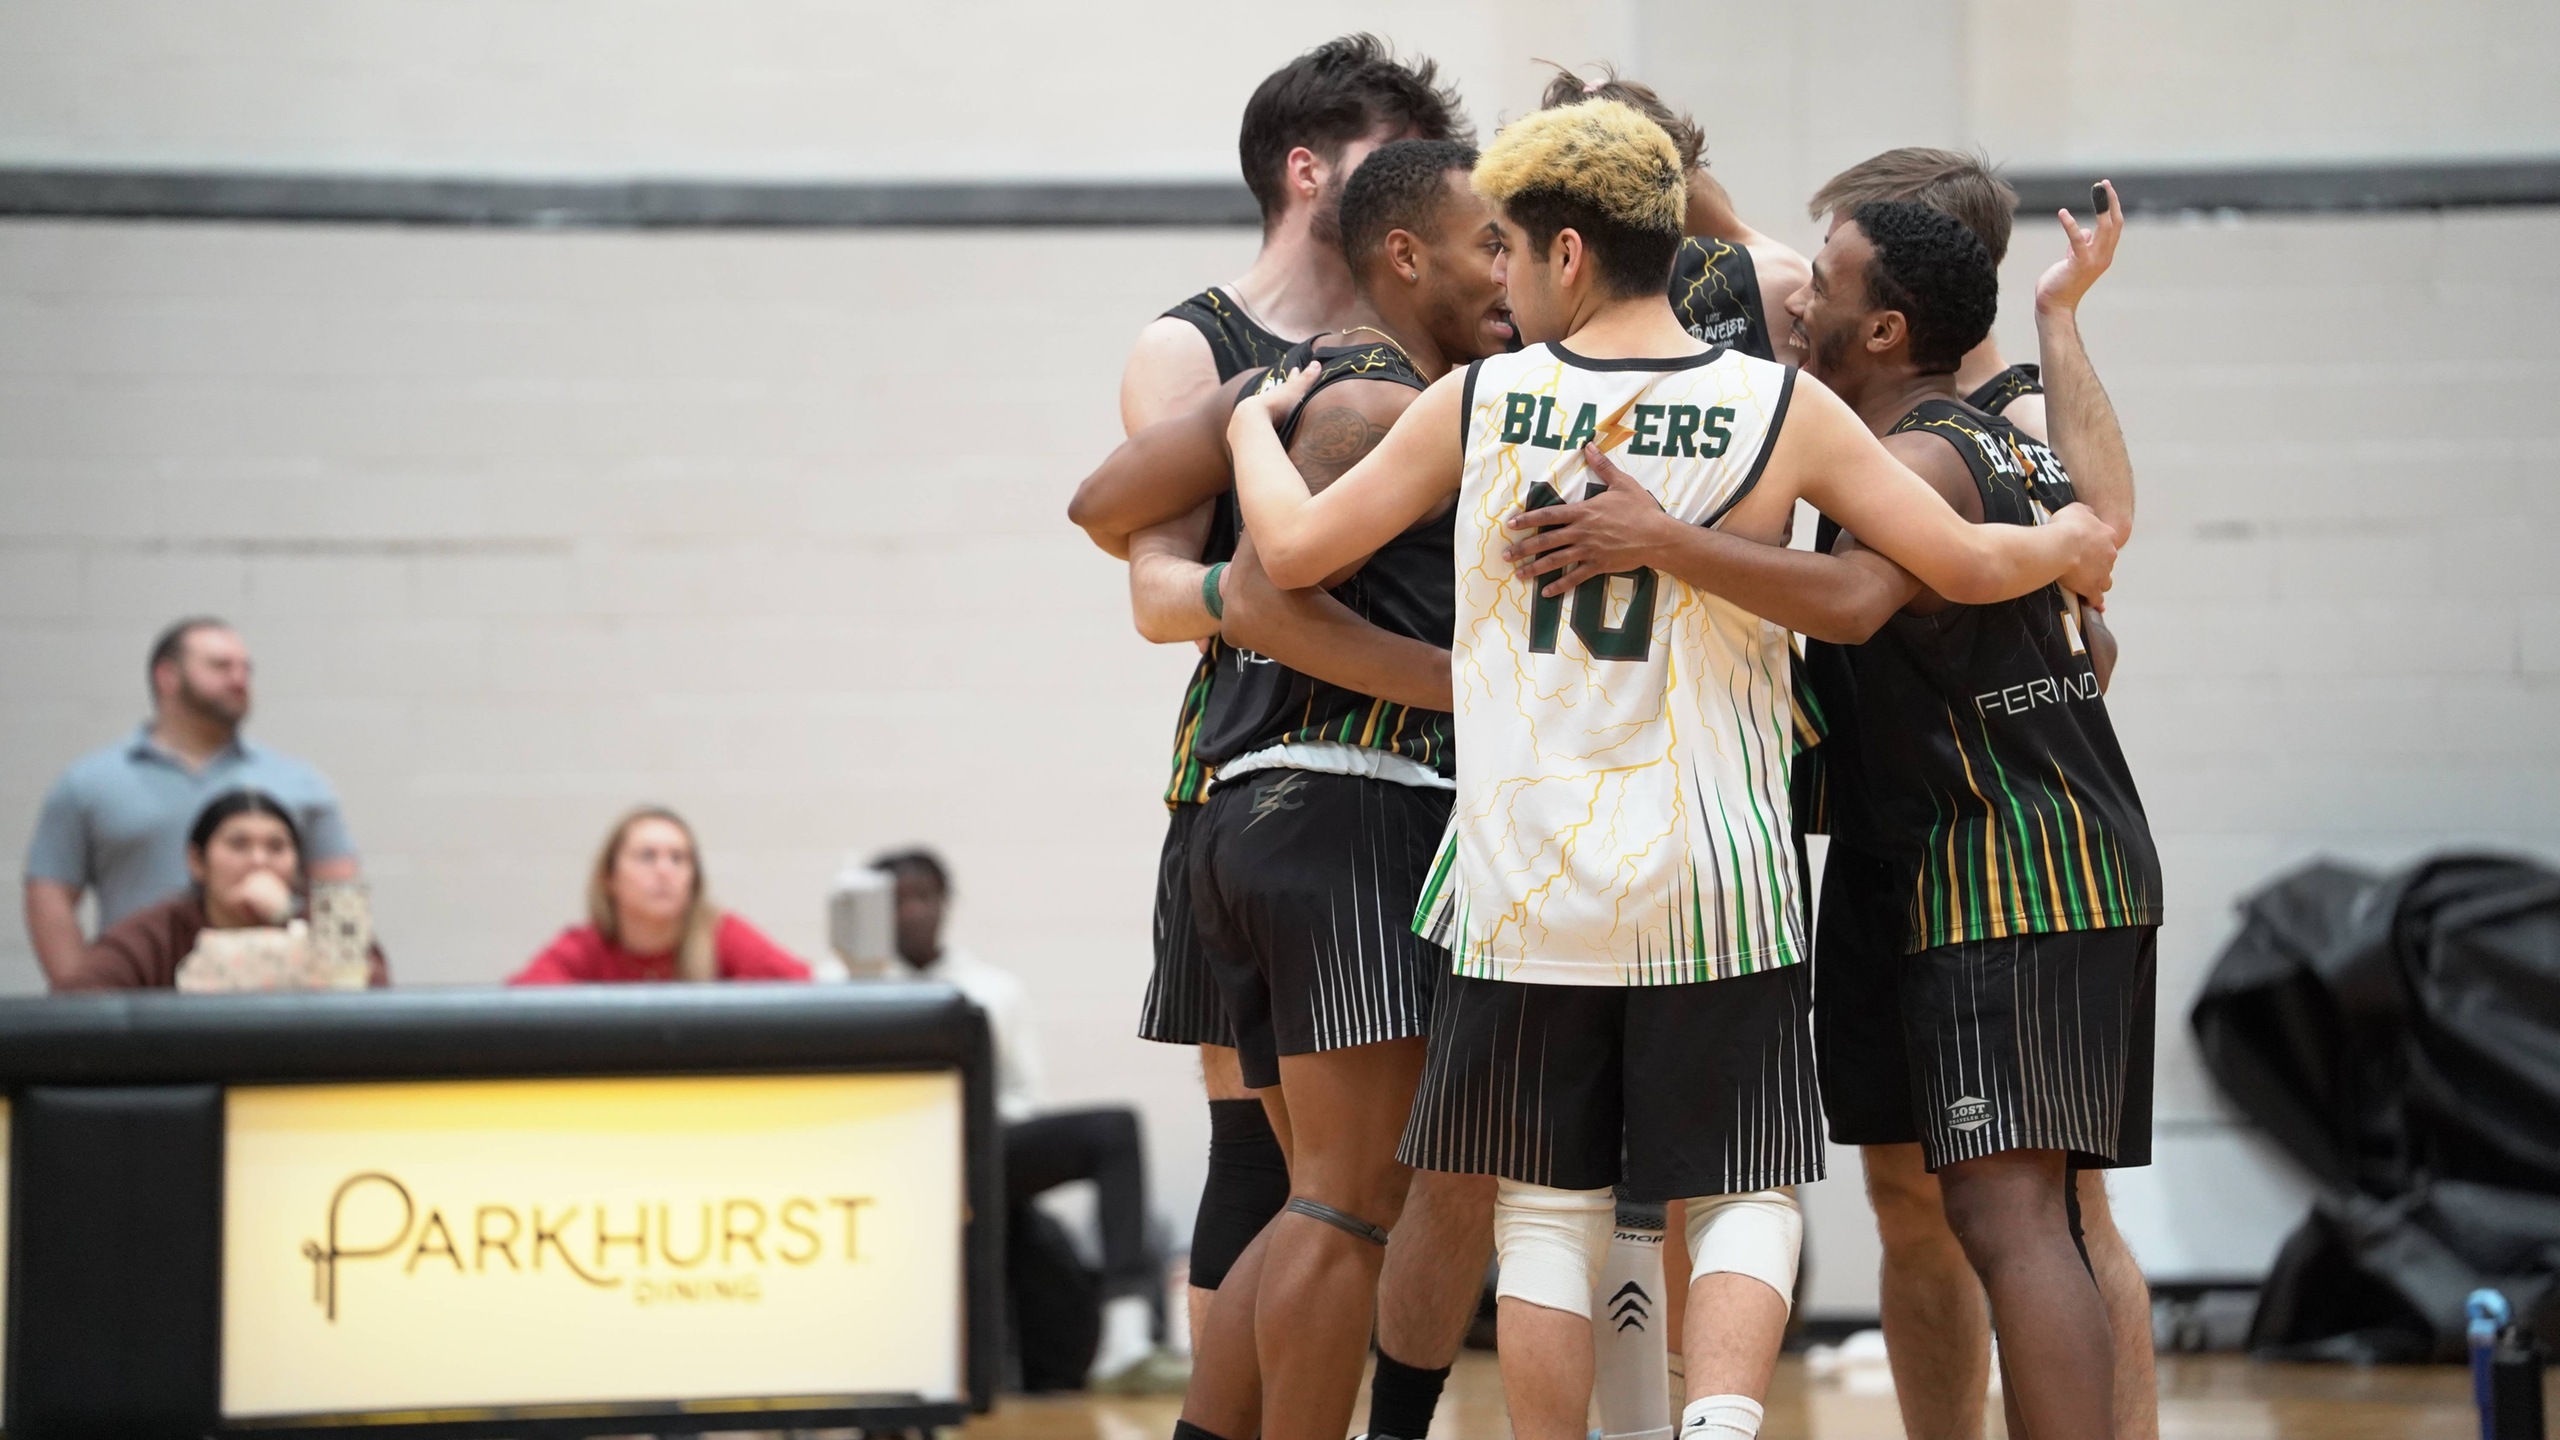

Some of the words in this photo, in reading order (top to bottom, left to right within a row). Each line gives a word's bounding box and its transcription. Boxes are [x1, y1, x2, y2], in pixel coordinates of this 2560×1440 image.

[1687, 317, 1747, 342] TRAVELER
[1949, 1115, 1979, 1125] TRAVELER
[1952, 1104, 1985, 1118] LOST
[303, 1172, 874, 1321] PARKHURST
[635, 1279, 763, 1304] DINING
